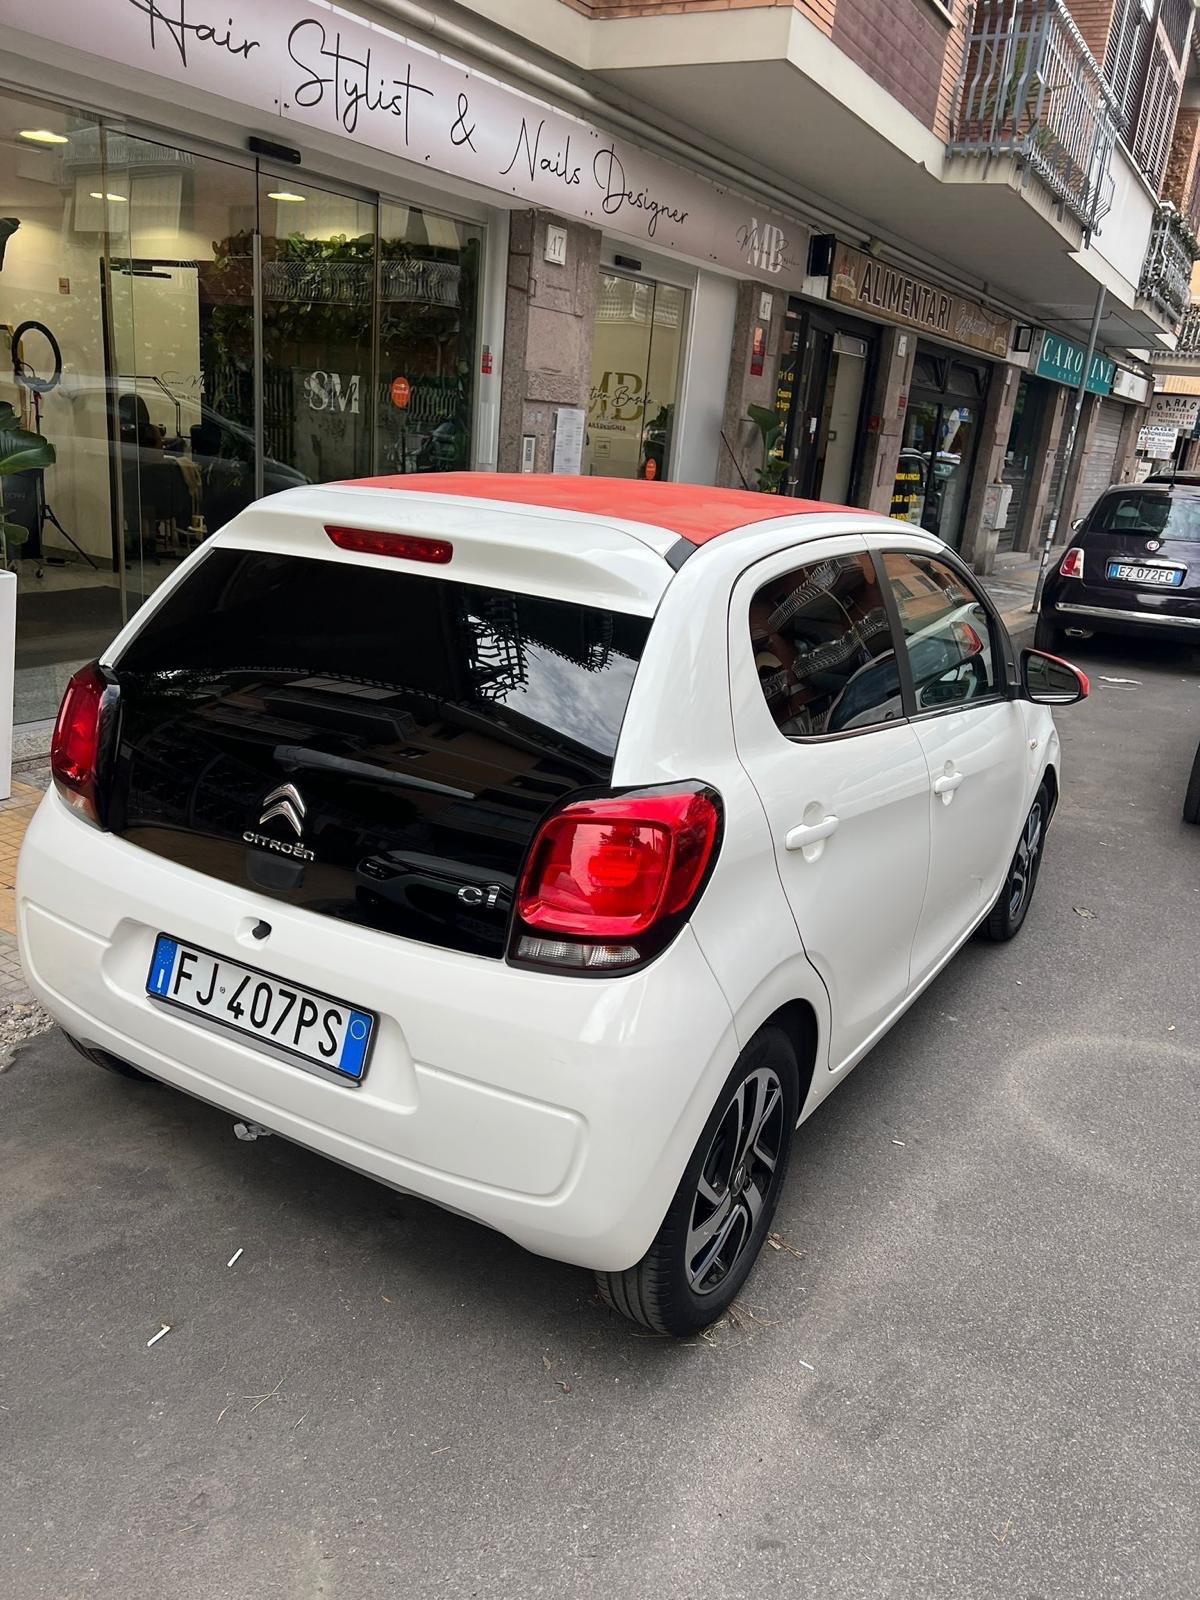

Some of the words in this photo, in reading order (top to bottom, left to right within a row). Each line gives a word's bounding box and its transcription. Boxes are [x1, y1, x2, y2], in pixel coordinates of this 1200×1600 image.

[130, 0, 260, 67] Hair
[288, 19, 434, 146] Stylist
[450, 93, 477, 153] &
[498, 117, 582, 185] Nails
[592, 143, 689, 238] Designer
[549, 234, 564, 257] 47
[857, 260, 954, 333] ALIMENTARI
[1042, 337, 1114, 384] CAROINE
[1118, 566, 1135, 578] EZ
[1136, 568, 1174, 582] 072FC
[457, 885, 500, 909] C1
[173, 950, 220, 1007] FJ
[226, 975, 344, 1059] 407PS
